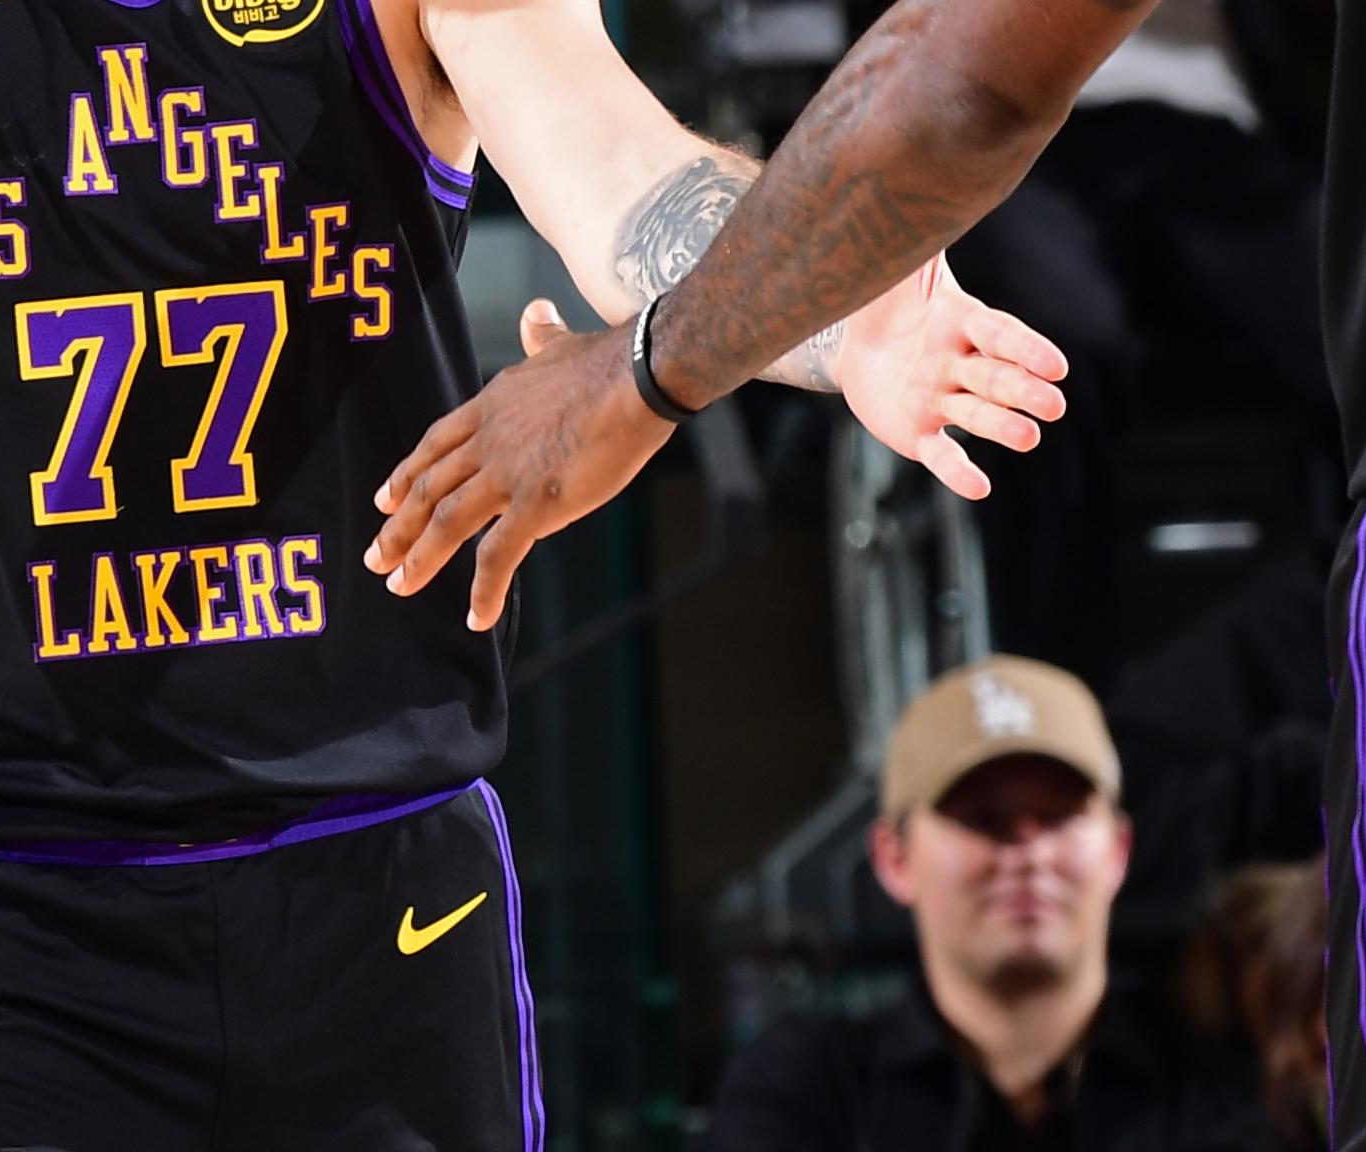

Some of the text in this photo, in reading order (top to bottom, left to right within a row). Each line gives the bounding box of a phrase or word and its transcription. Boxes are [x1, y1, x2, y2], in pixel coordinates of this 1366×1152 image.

[232, 3, 282, 26] 비비고
[63, 41, 397, 342] ANGELES
[13, 278, 290, 528] 77
[26, 533, 328, 663] LAKERS
